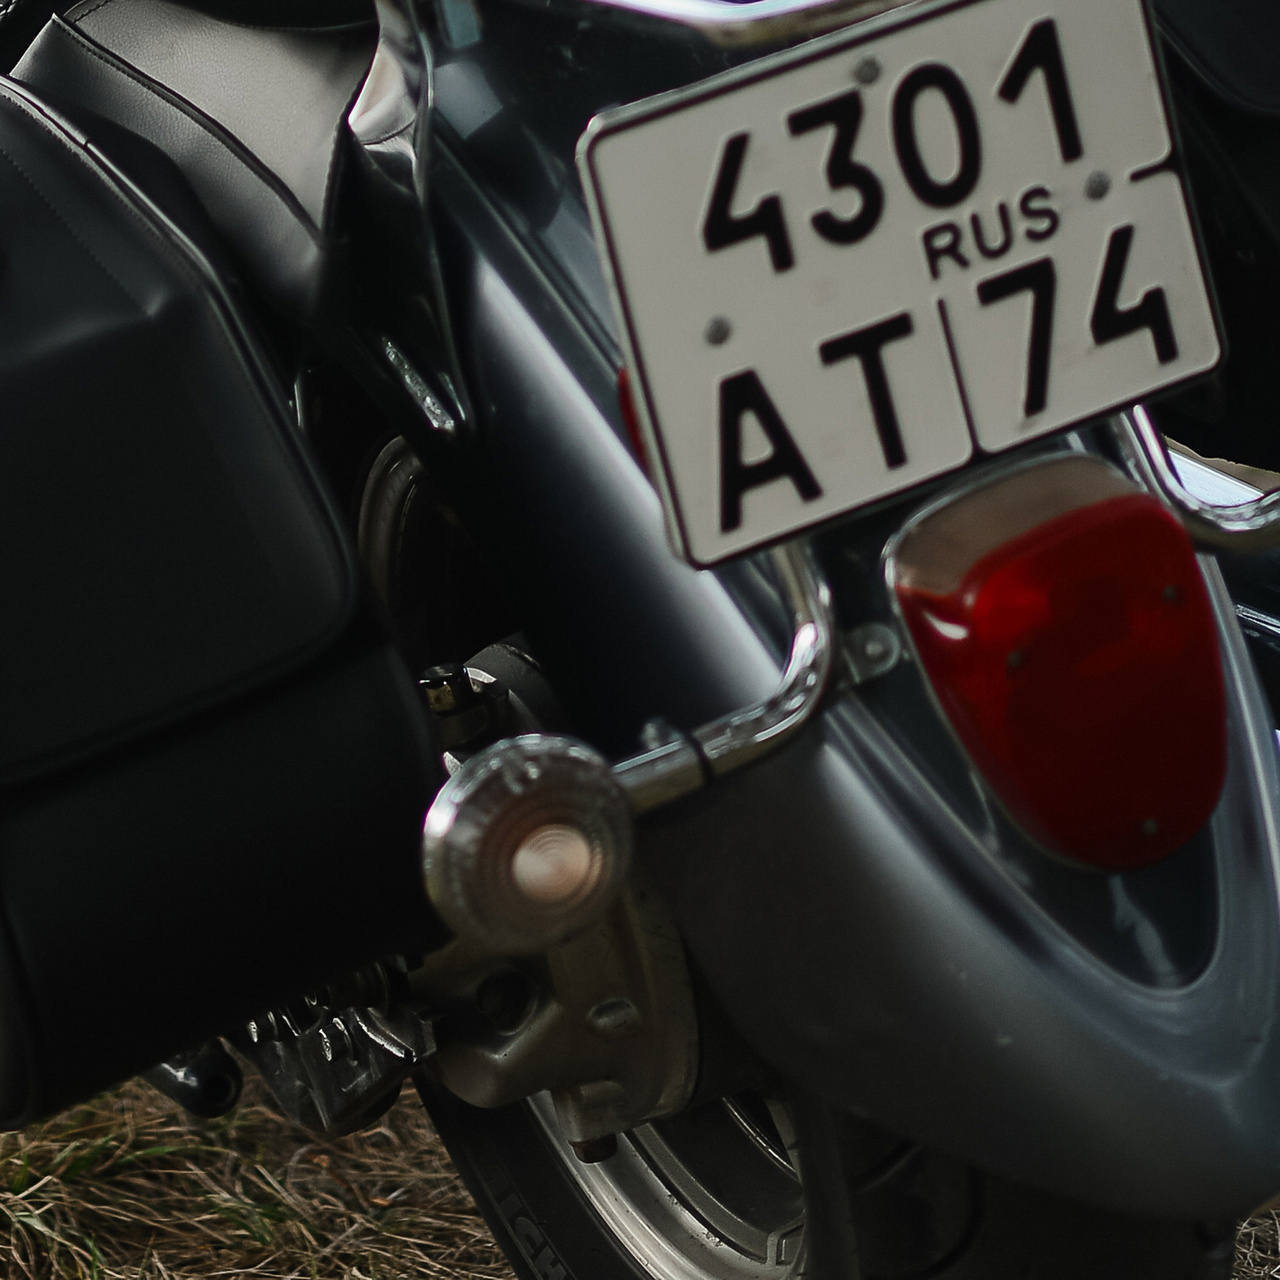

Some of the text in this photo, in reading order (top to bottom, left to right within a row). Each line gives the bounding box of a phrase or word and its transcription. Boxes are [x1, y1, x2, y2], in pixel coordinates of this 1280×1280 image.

[702, 17, 1084, 274] 4301
[921, 185, 1061, 281] RUS
[719, 223, 1180, 535] AT 74
